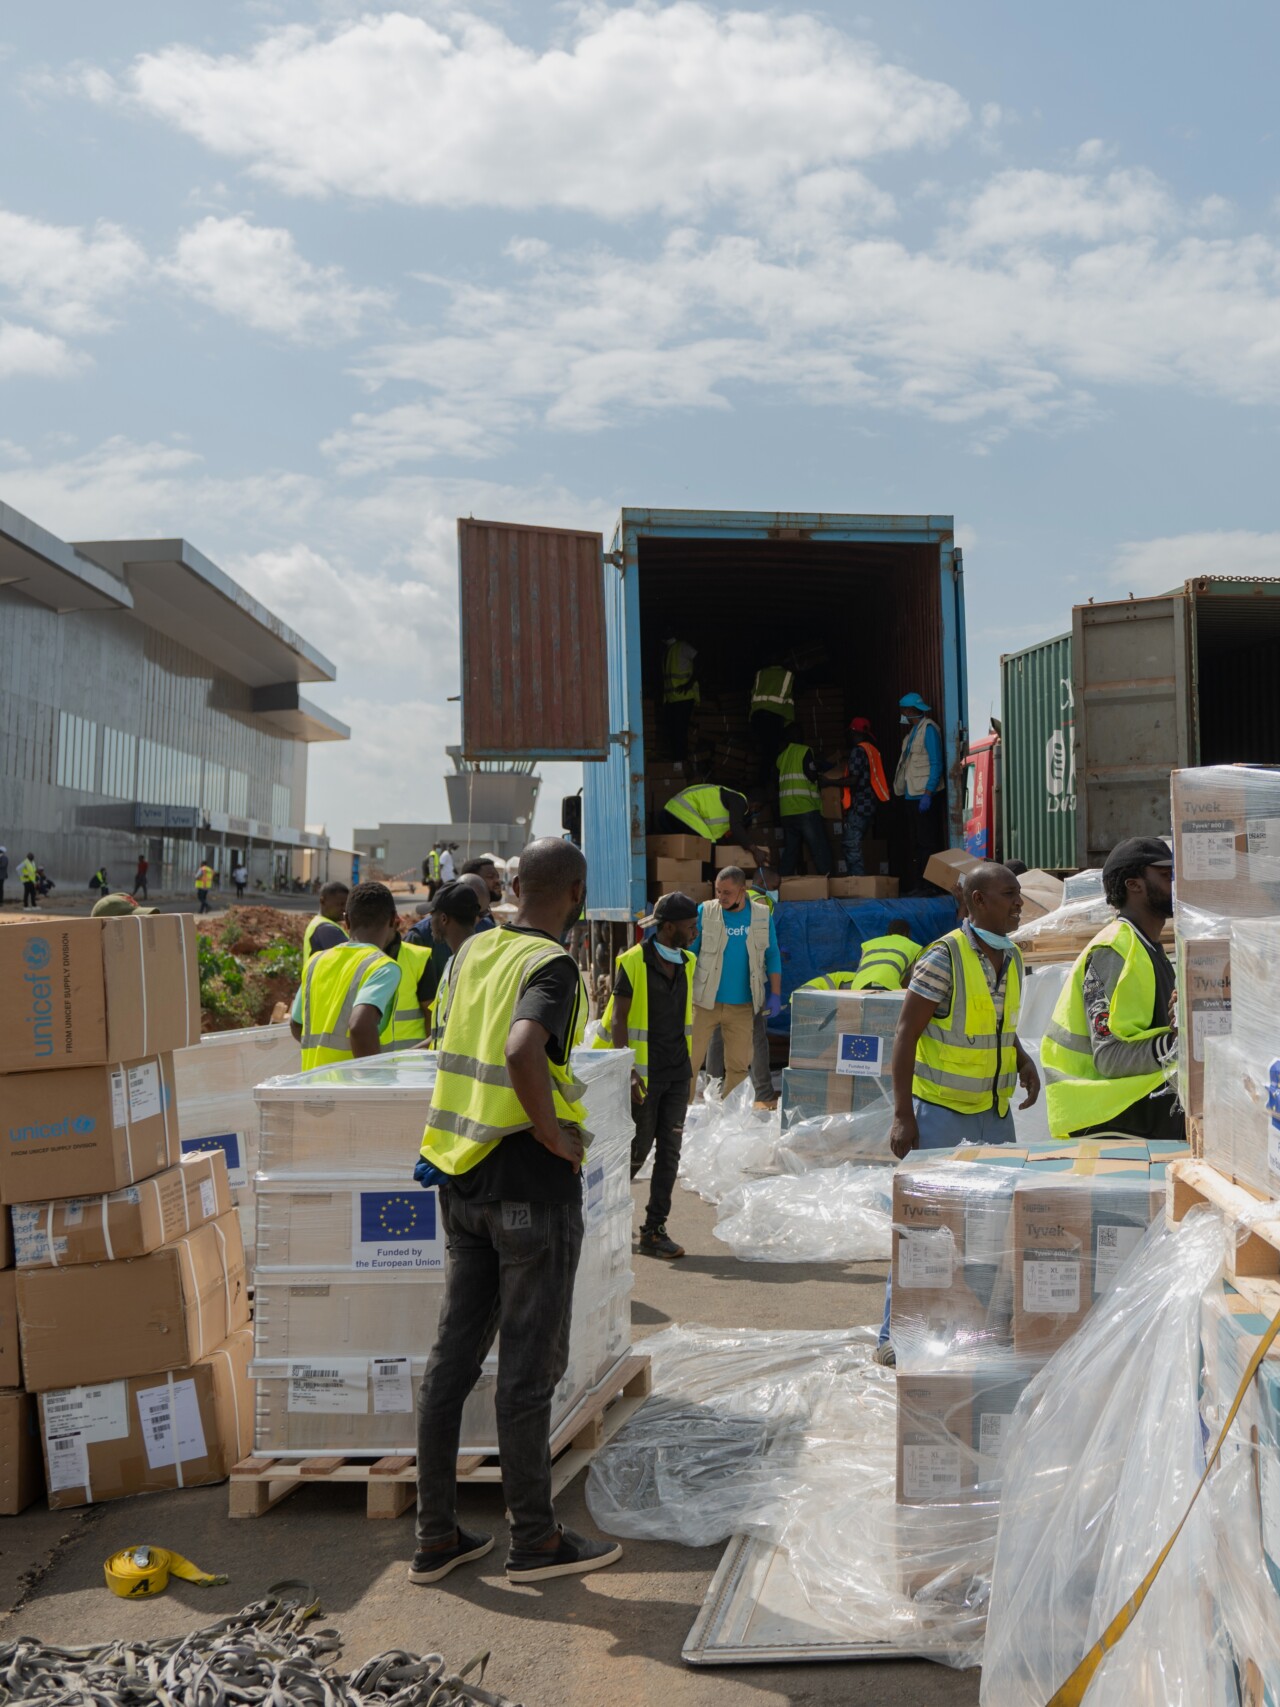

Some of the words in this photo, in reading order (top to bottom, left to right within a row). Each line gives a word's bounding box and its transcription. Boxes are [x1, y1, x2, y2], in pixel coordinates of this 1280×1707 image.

[1184, 801, 1221, 815] Tyvek
[61, 932, 71, 967] DIVISION
[63, 969, 72, 998] SUPPLY
[1194, 975, 1231, 992] Tyvek
[24, 973, 54, 1057] unicef
[64, 998, 73, 1029] UNICEF
[65, 1029, 73, 1054] FROM
[9, 1117, 70, 1143] unicef
[902, 1203, 940, 1219] Tyvek
[1026, 1223, 1065, 1240] Tyvek
[377, 1247, 410, 1257] Funded
[411, 1247, 423, 1258] by
[355, 1260, 370, 1268] the
[371, 1259, 414, 1269] European
[415, 1258, 441, 1267] Union
